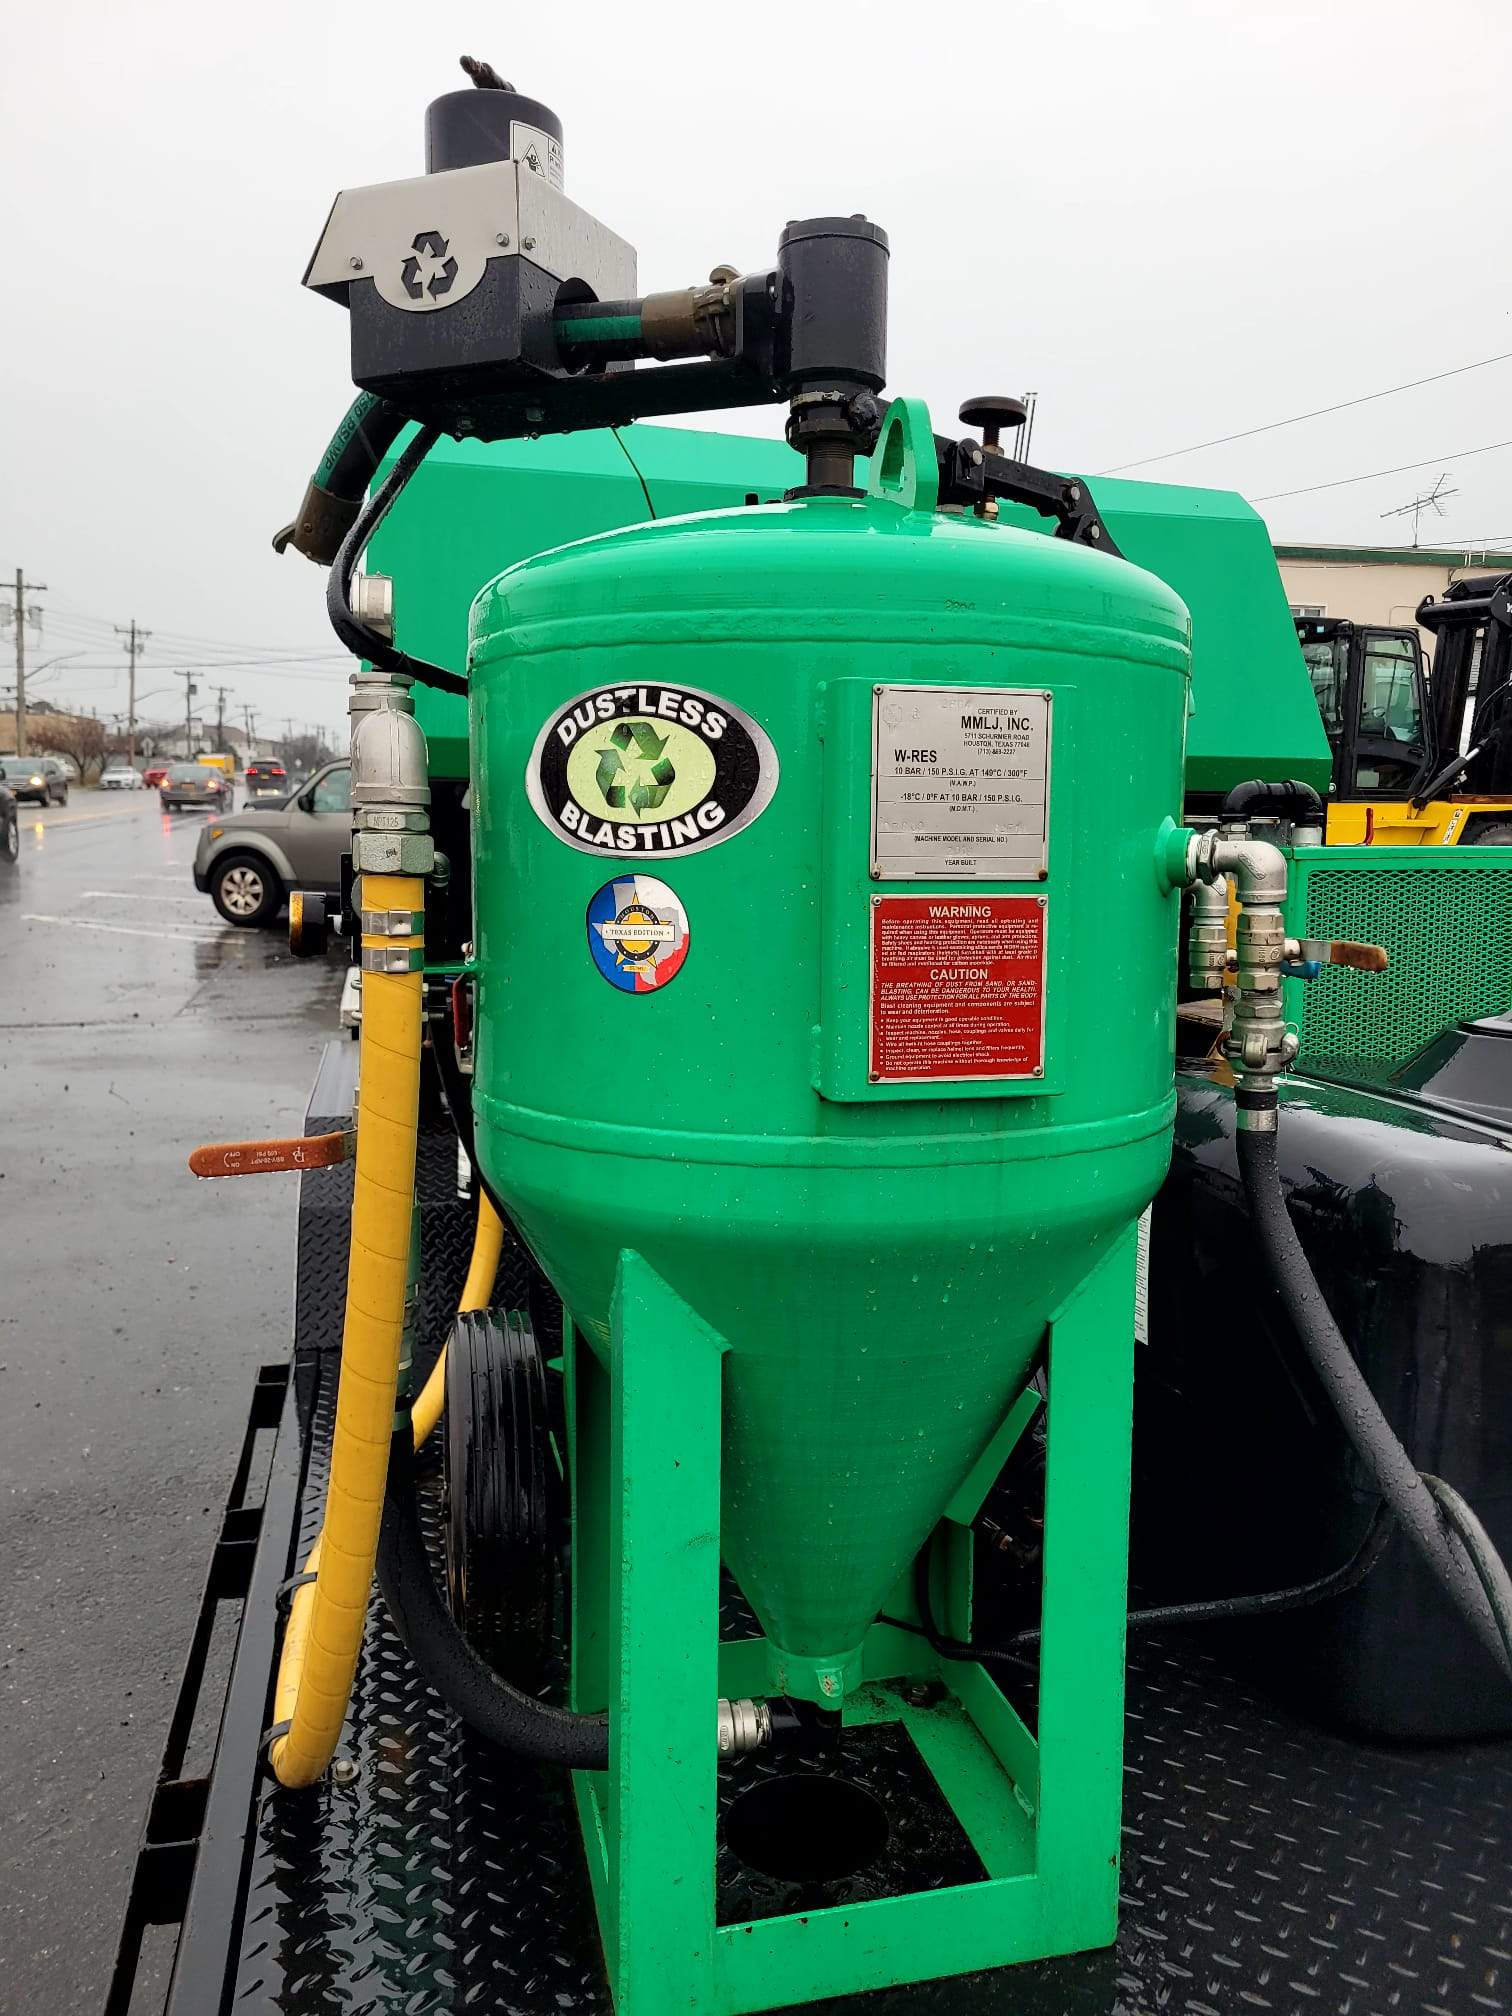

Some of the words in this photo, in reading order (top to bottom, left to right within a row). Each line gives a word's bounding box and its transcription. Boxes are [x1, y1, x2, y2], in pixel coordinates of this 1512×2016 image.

[340, 416, 356, 445] PSI
[556, 688, 727, 747] DUSTLESS
[961, 716, 1002, 732] MMLJ,
[1008, 717, 1033, 731] INC.
[894, 749, 937, 763] W-RES
[942, 768, 968, 776] P.S.I.G.
[926, 793, 938, 801] 0°F
[984, 794, 996, 802] 150
[560, 800, 726, 850] BLASTING
[929, 906, 992, 917] WARNING
[633, 929, 664, 937] EDITION
[930, 969, 988, 980] CAUTION
